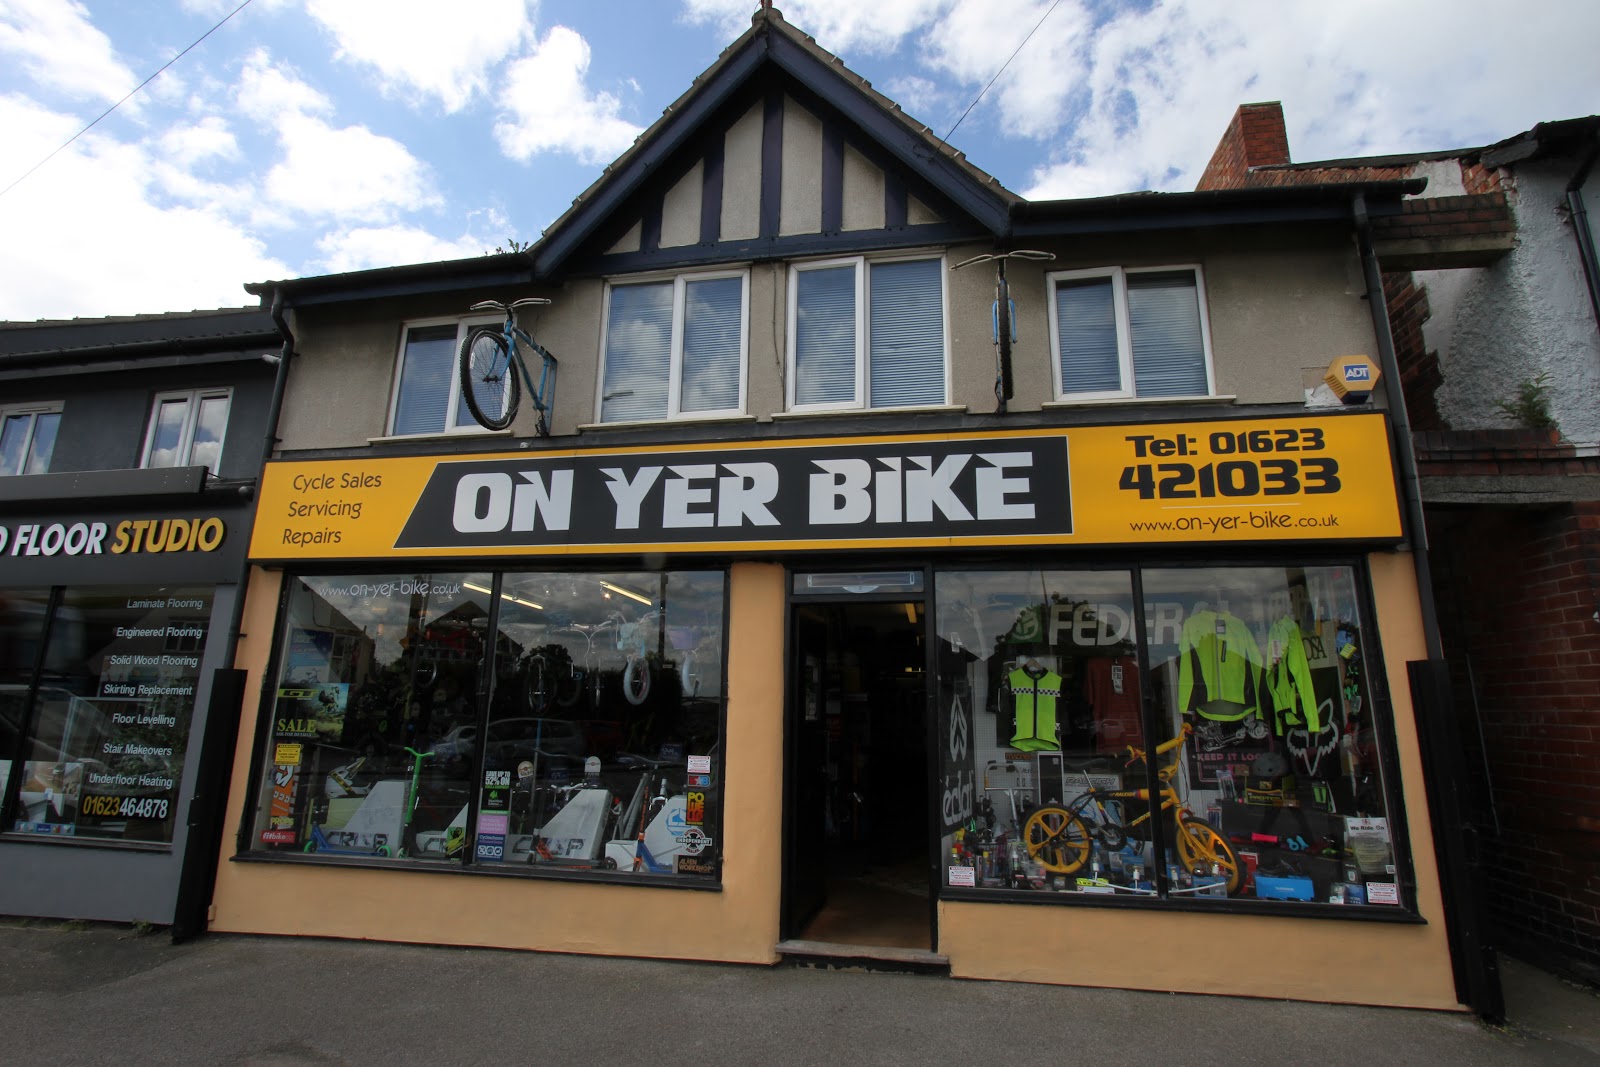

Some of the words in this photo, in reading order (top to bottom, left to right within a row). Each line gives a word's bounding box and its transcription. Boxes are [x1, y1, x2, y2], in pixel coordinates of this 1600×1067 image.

[1345, 367, 1369, 378] ADT
[1124, 433, 1198, 458] Tel:
[1208, 427, 1326, 455] 01623
[292, 473, 335, 493] Cycle
[340, 472, 382, 490] Sales
[1118, 457, 1342, 500] 421033
[452, 469, 575, 533] ON
[598, 461, 782, 530] YER
[808, 451, 1036, 525] BIKE
[287, 500, 362, 519] Servicing
[1129, 510, 1340, 534] www.on-yer-bike.co.uk
[11, 522, 108, 556] FLOOR
[111, 517, 225, 554] STUDIO
[282, 527, 342, 547] Repairs
[318, 580, 461, 598] www.on-yer-bike.co.uk
[127, 598, 165, 609] Laminate
[167, 598, 204, 610] Flooring
[1048, 602, 1209, 646] FEDER
[116, 626, 164, 638] Engineered
[166, 626, 203, 639] Flooring
[110, 655, 132, 666] Solid
[134, 655, 160, 666] Wood
[161, 655, 198, 668] Flooring
[103, 684, 136, 697] Skirting
[137, 684, 193, 698] Replacement
[112, 713, 136, 724] Floor
[137, 714, 176, 727] Levelling
[277, 718, 317, 733] SALE
[103, 743, 123, 754] Stair
[125, 743, 172, 756] Makeovers
[1196, 753, 1225, 762] KEEP
[1227, 753, 1238, 761] IT
[89, 773, 137, 785] Underfloor
[138, 774, 173, 789] Heating
[485, 776, 499, 786] 52%
[1066, 776, 1116, 786] RALEIGH
[83, 796, 169, 819] 01623464878
